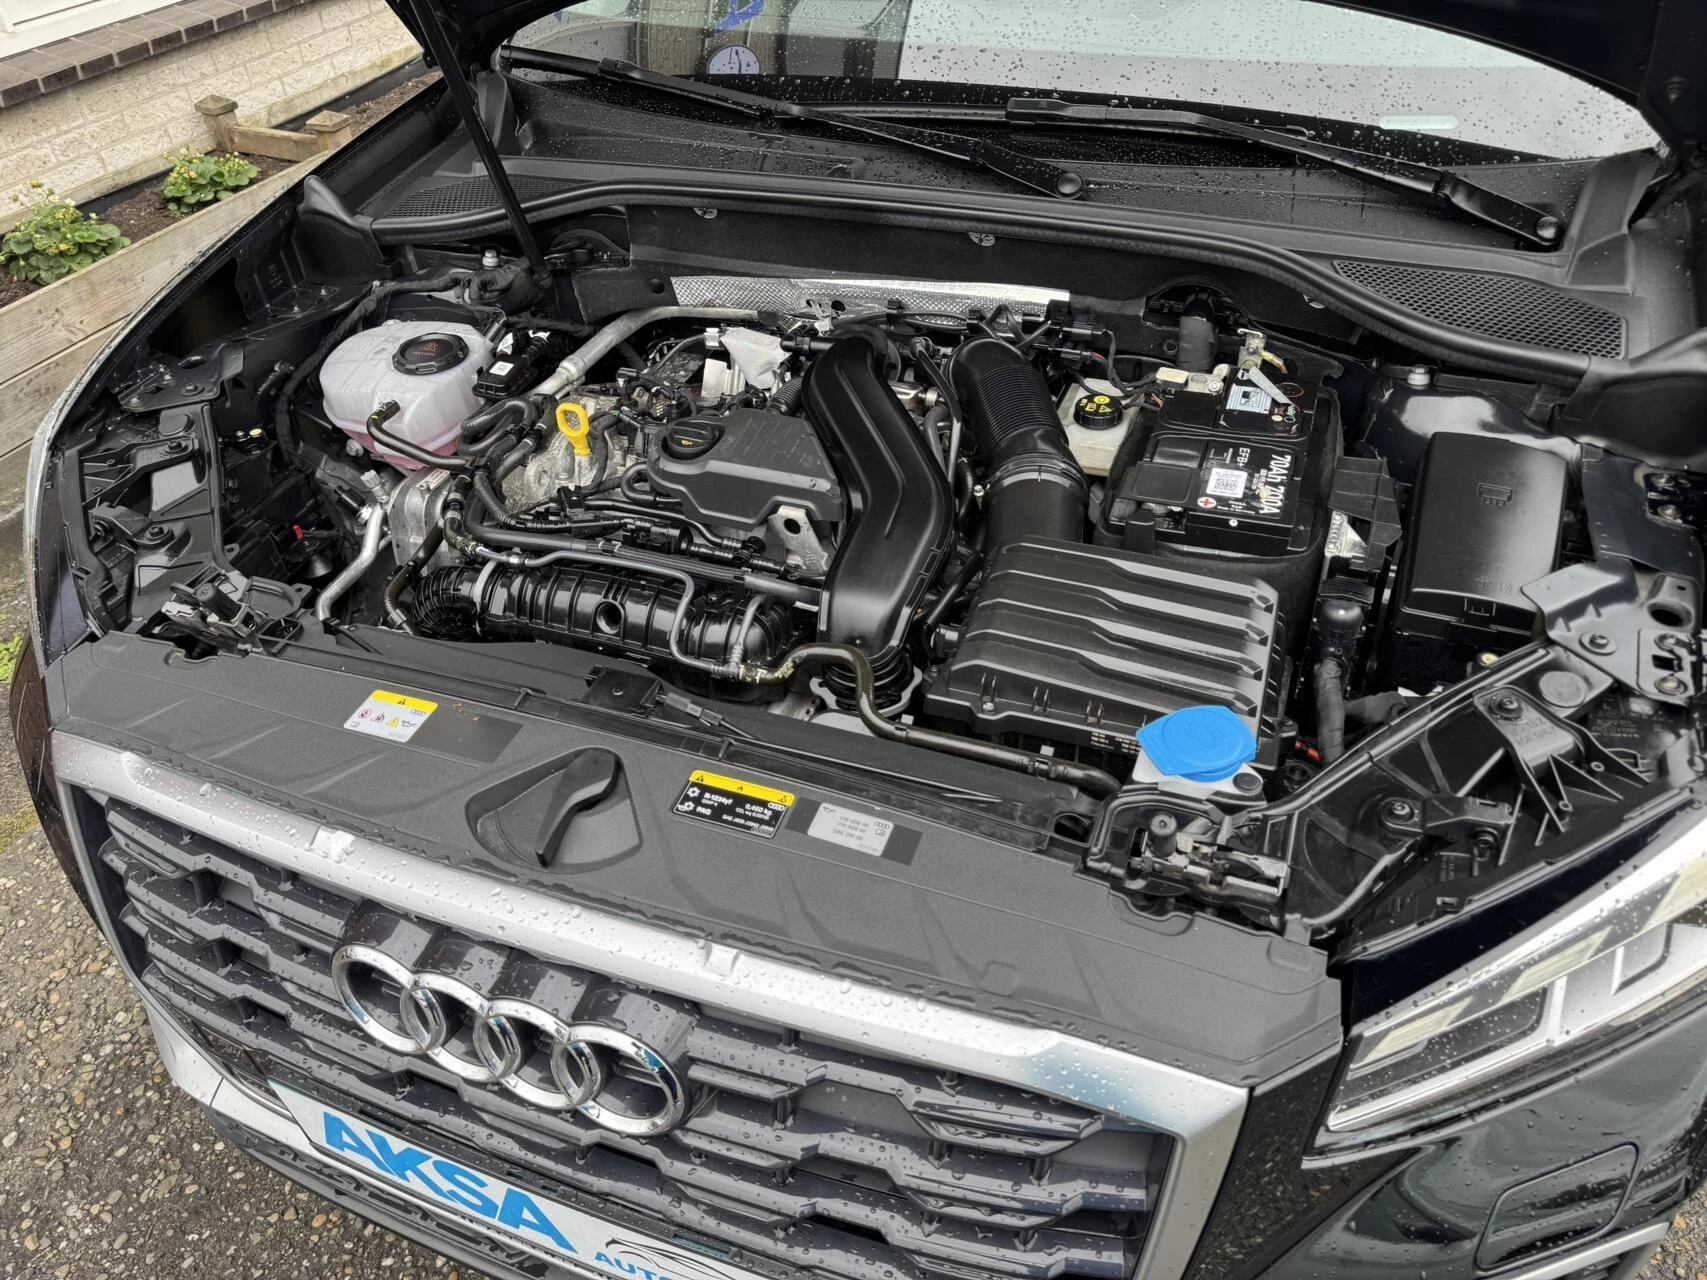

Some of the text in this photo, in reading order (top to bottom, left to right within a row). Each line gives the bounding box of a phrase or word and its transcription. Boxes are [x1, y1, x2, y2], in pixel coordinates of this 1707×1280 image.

[1236, 447, 1250, 467] EFB+
[1266, 454, 1292, 483] 70Ah
[1258, 485, 1285, 514] 700A
[696, 806, 712, 816] PAG
[323, 1111, 578, 1253] AKSA
